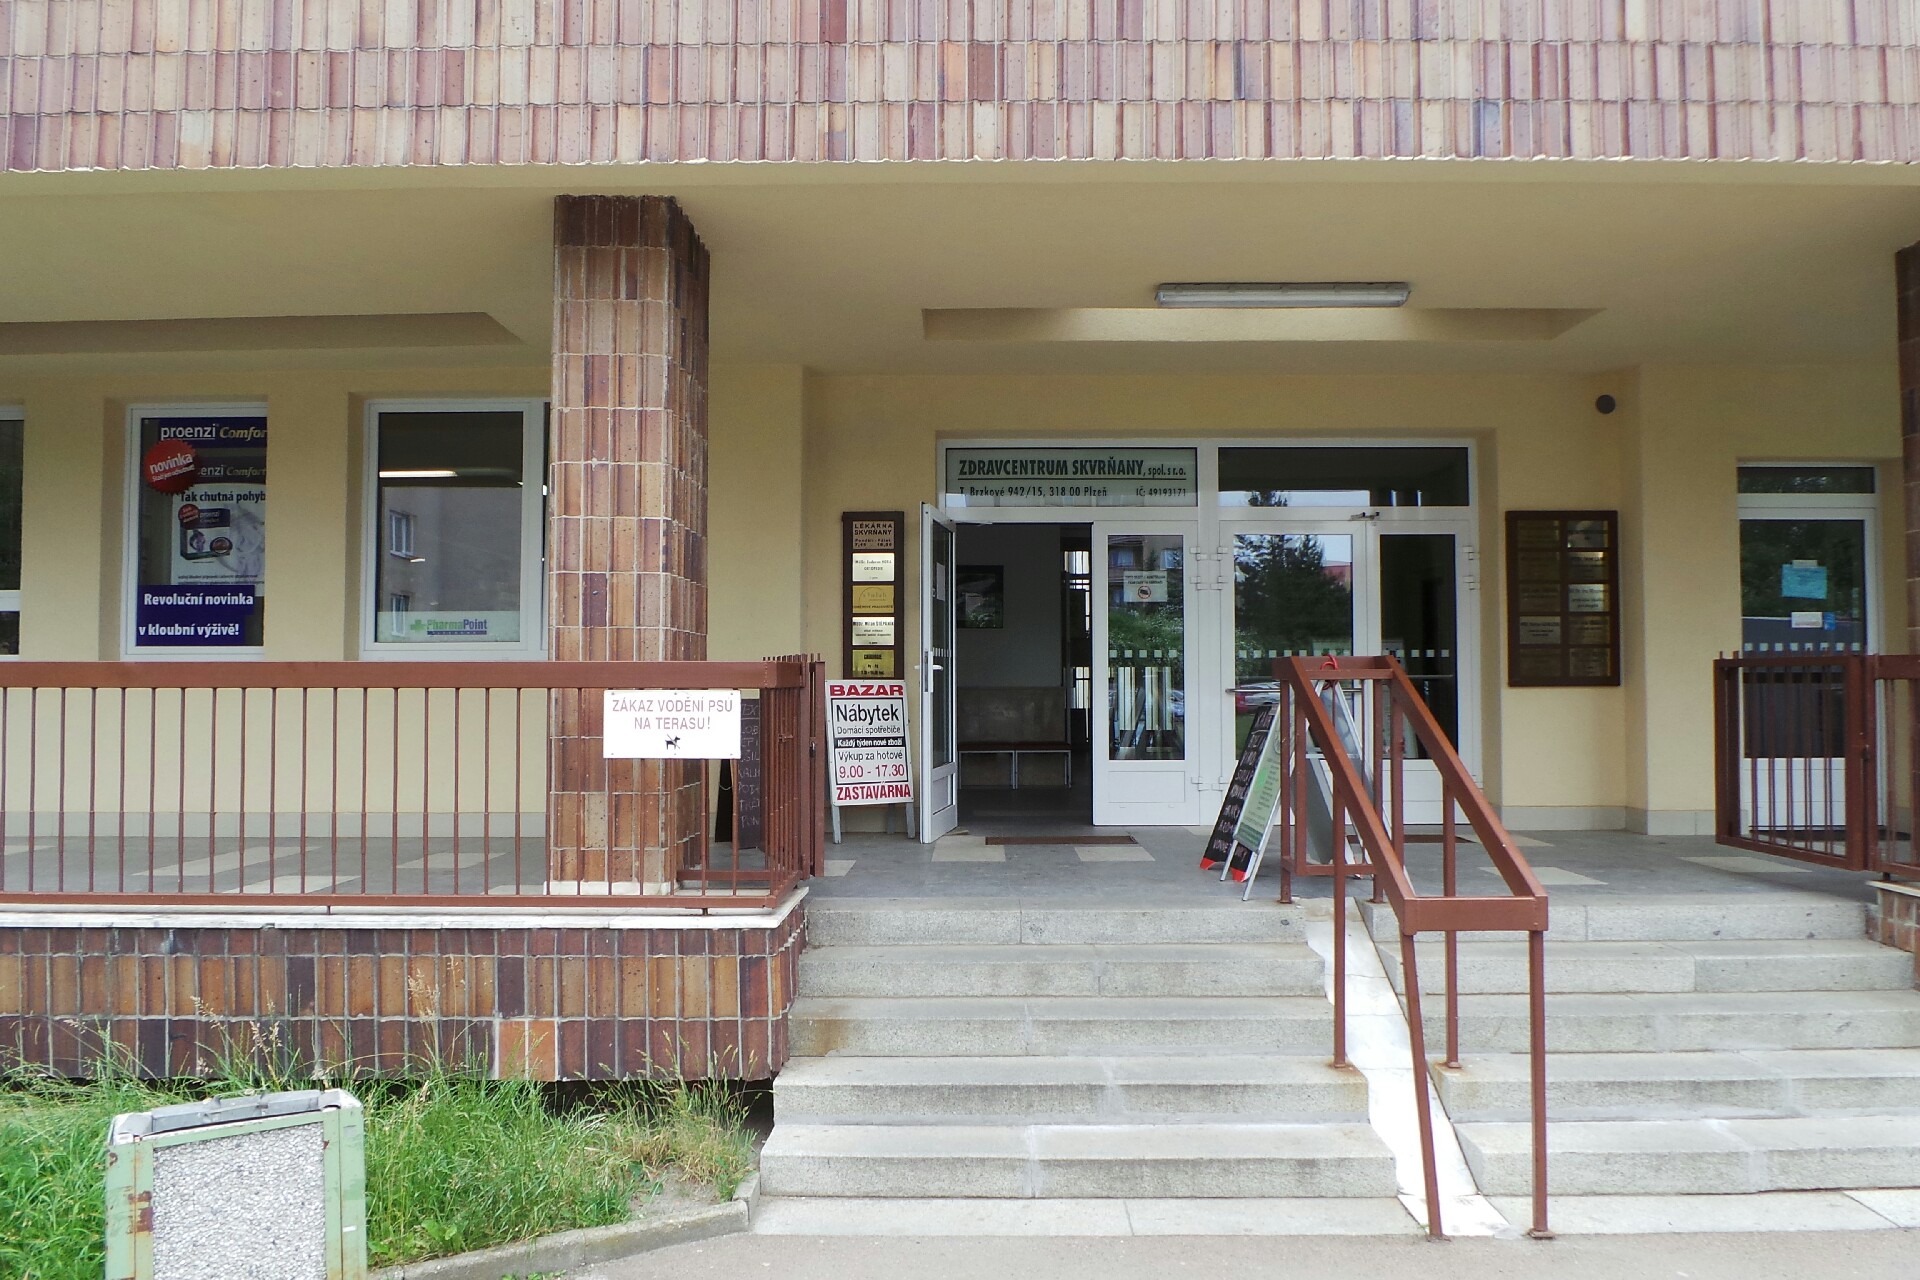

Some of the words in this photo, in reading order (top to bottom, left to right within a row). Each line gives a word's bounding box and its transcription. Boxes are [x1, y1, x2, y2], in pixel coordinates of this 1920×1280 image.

[160, 424, 216, 441] proenzi
[150, 453, 194, 474] novinka
[958, 460, 1068, 476] ZDRAVCENTRUM
[1072, 456, 1146, 476] SKVRŇANY,
[200, 490, 233, 502] chutná
[970, 486, 1004, 496] Brzkové
[1008, 486, 1046, 498] 942/15,
[1050, 486, 1066, 496] 318
[1070, 486, 1080, 496] 00
[1084, 486, 1106, 496] Plzeň
[1148, 488, 1186, 496] 49193171
[144, 593, 203, 605] Revoluční
[205, 593, 254, 605] novinka
[139, 626, 146, 636] v
[148, 623, 195, 636] kloubní
[197, 623, 239, 638] výživě!
[427, 619, 487, 630] PharmaPoint
[830, 684, 903, 696] BAZAR
[612, 697, 654, 712] ZÁKAZ
[658, 697, 704, 712] VODĚNÍ
[836, 704, 899, 725] Nábytek
[634, 717, 651, 730] NA
[656, 716, 710, 730] TERASU!
[837, 726, 863, 734] Domácí
[866, 726, 900, 735] spotřebiče
[838, 739, 856, 748] Každý
[856, 739, 872, 747] týden
[838, 751, 863, 762] Výkup
[877, 750, 903, 760] hotové
[839, 766, 863, 778] 9.00
[876, 764, 904, 777] 17.30
[836, 781, 911, 800] ZASTAVÁRNA
